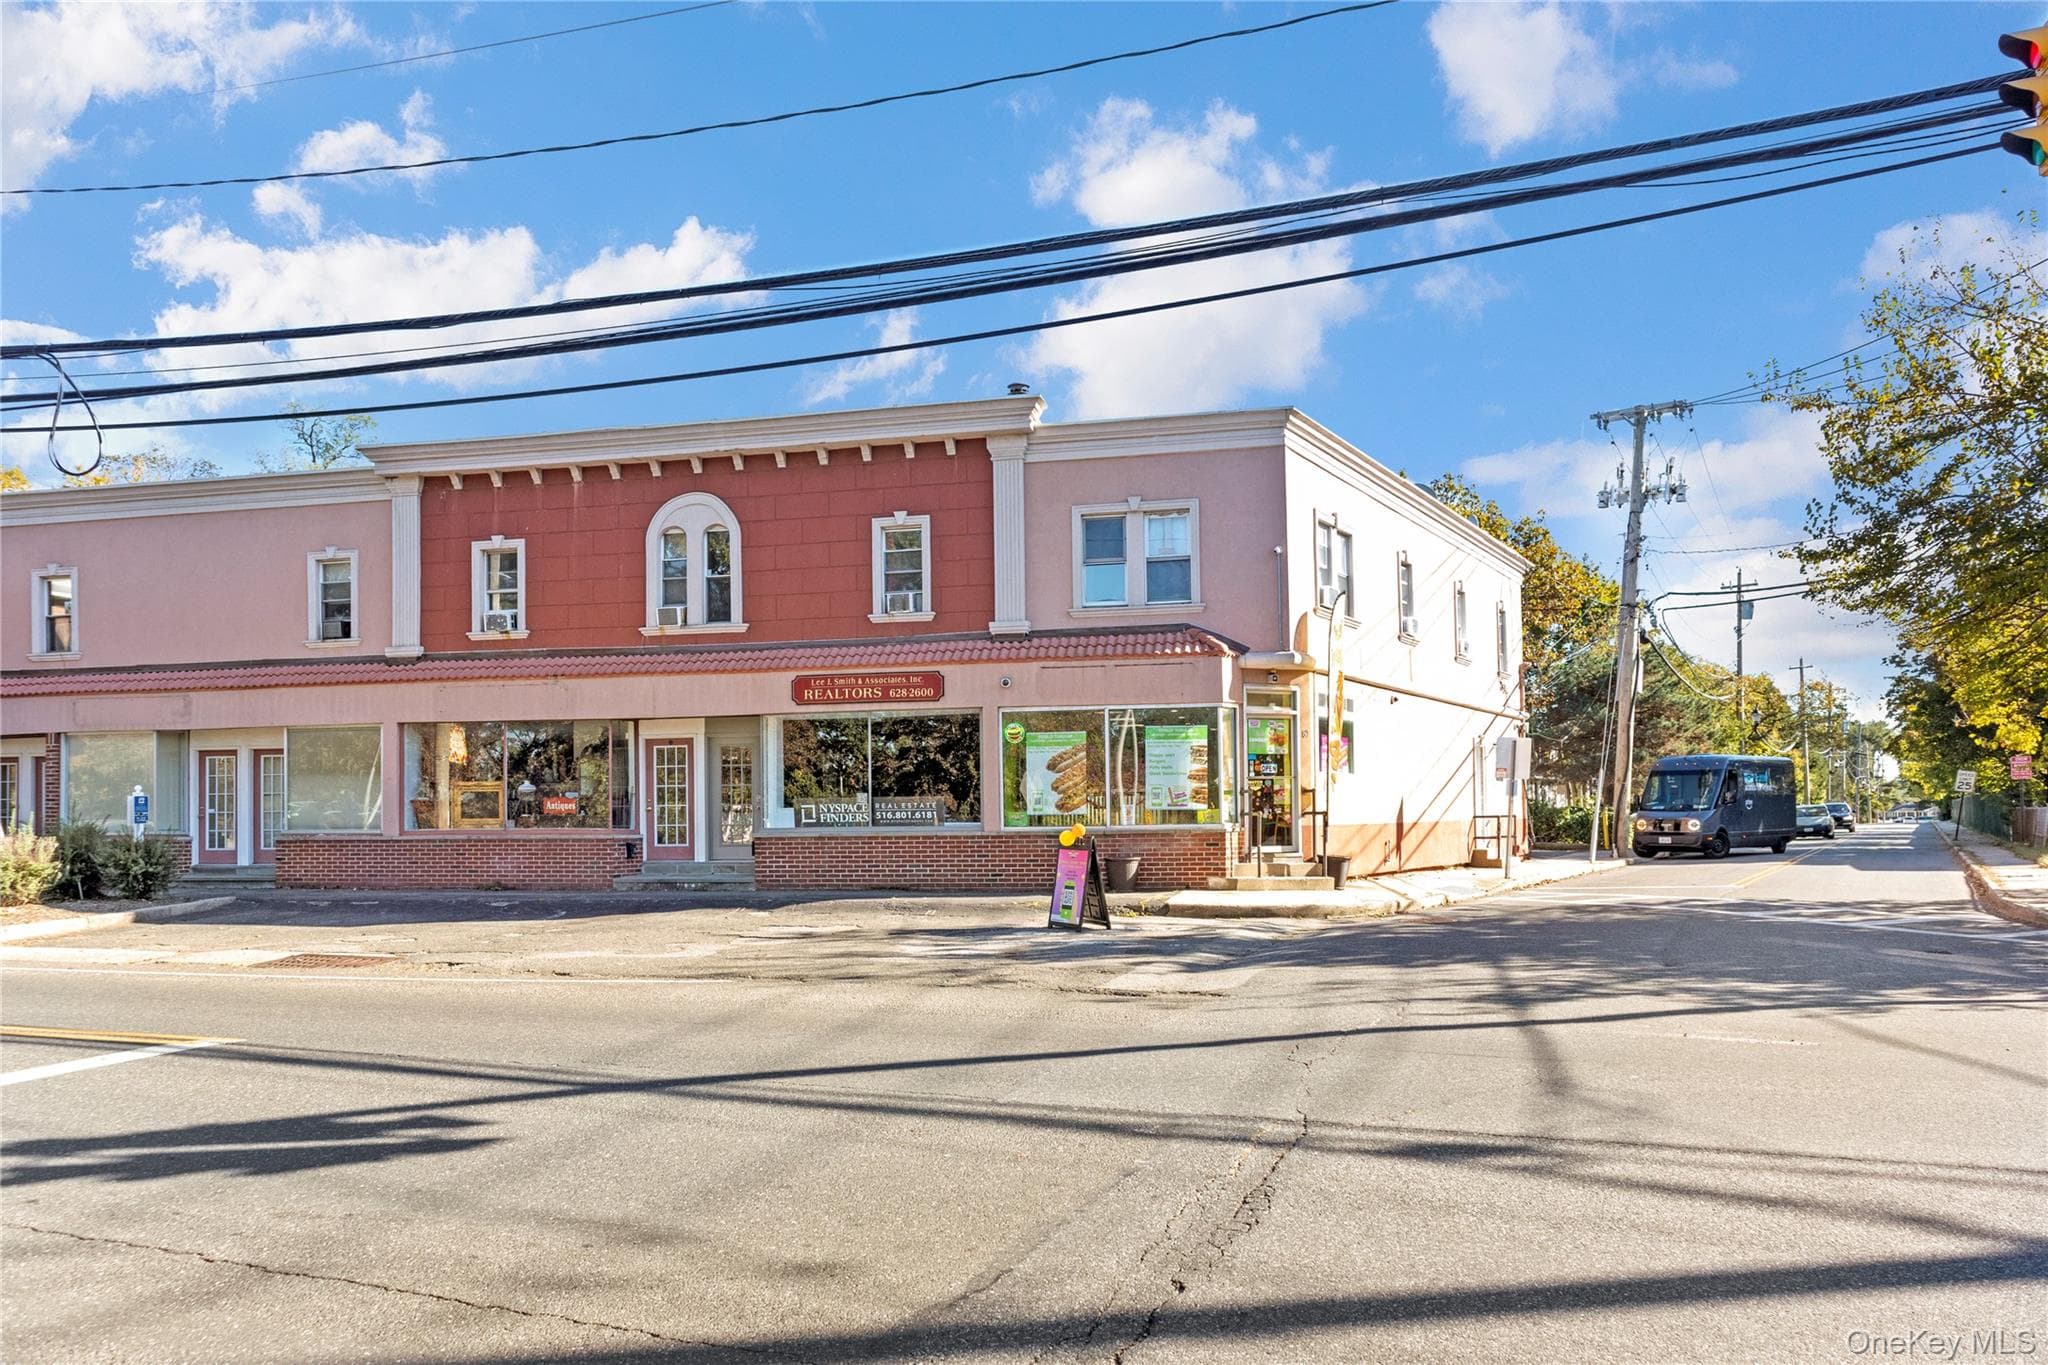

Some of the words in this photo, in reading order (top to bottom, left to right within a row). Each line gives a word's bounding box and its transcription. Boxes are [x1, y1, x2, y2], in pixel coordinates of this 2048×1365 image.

[811, 679, 825, 687] Lee
[834, 677, 856, 686] Smith
[857, 677, 863, 685] &
[910, 675, 925, 684] Inc.
[804, 687, 882, 700] REALTORS
[889, 687, 934, 698] 628-2600
[1262, 764, 1277, 773] OPEN
[1956, 781, 1972, 790] 25
[546, 800, 577, 812] Antiques
[819, 803, 868, 813] NYSPACE
[901, 801, 937, 809] ESTATE
[820, 813, 869, 823] FINDERS
[876, 811, 937, 820] 516.801.6181
